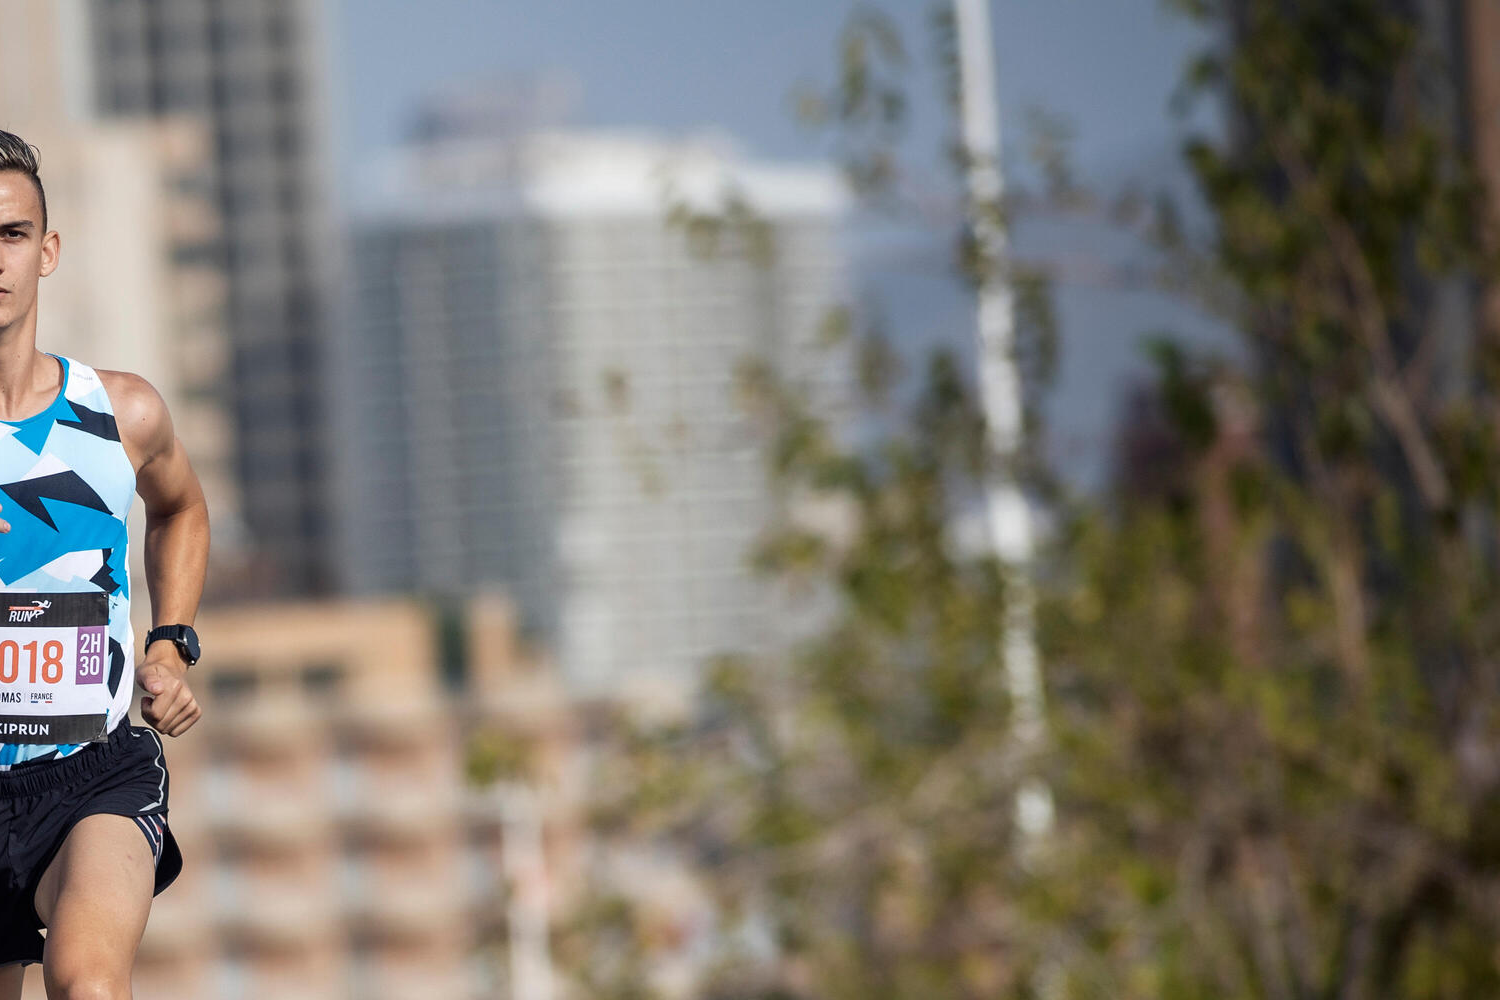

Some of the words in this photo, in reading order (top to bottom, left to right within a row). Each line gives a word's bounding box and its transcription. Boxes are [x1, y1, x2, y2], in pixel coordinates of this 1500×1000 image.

[8, 610, 32, 622] RUN
[79, 633, 101, 654] 2H
[79, 655, 100, 677] 30
[30, 692, 53, 700] FRANCE
